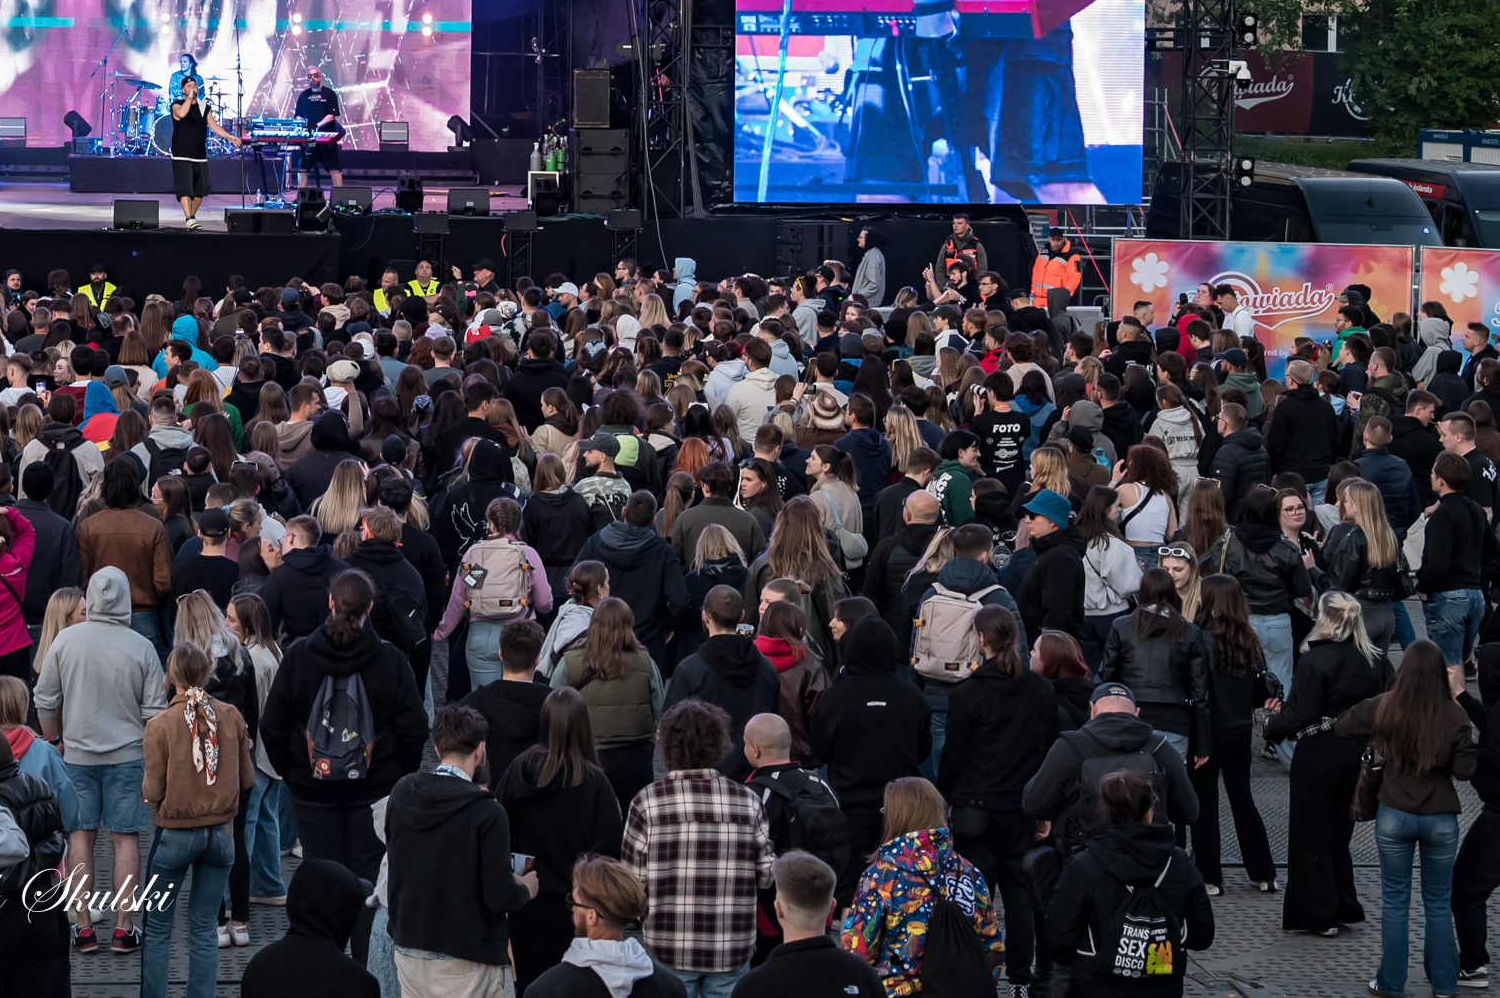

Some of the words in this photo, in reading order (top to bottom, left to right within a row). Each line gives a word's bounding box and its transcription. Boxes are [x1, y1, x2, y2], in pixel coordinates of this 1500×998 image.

[992, 423, 1021, 433] FOTO
[1123, 924, 1150, 940] TRANS
[1117, 938, 1148, 958] SEX
[1115, 955, 1144, 969] DISCO
